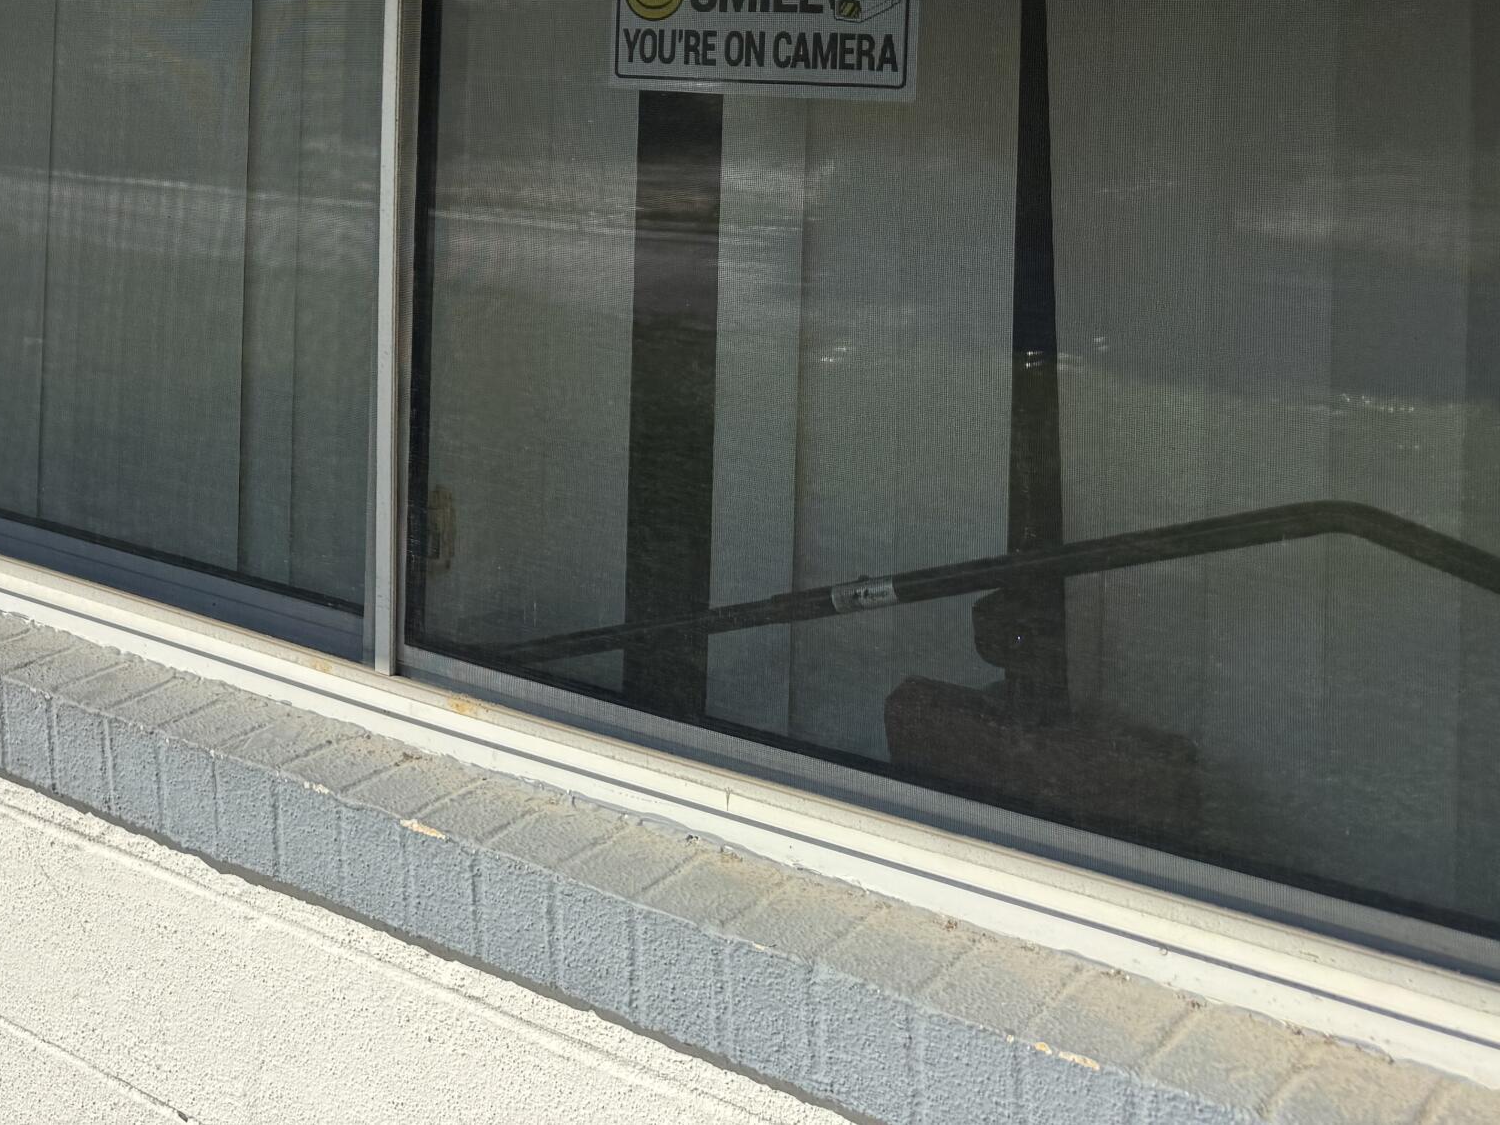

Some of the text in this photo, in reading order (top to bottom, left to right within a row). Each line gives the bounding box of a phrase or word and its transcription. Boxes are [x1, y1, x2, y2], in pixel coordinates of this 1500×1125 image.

[623, 28, 898, 72] YOU'RE ON CAMERA
